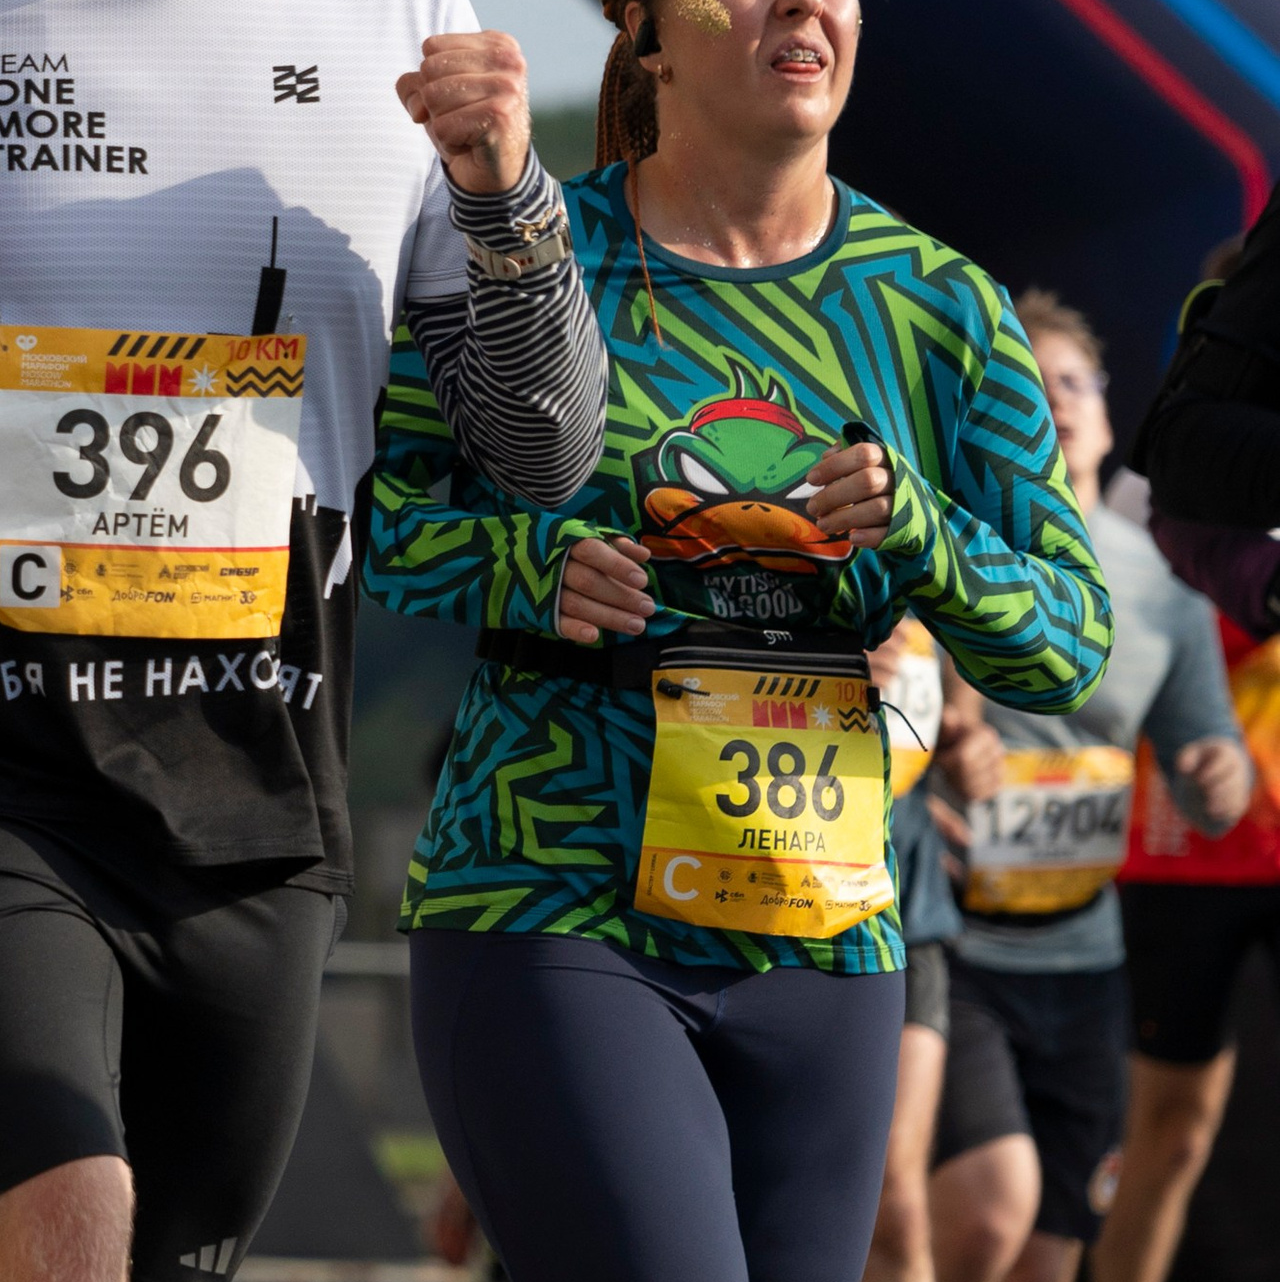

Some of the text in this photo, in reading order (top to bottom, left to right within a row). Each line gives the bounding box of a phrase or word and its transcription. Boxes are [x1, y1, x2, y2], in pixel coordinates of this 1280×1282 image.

[53, 408, 231, 503] 396
[92, 507, 189, 538] АРТЁМ
[68, 661, 124, 702] НЕ
[716, 738, 845, 822] 386
[738, 827, 826, 853] ЛЕНАРА
